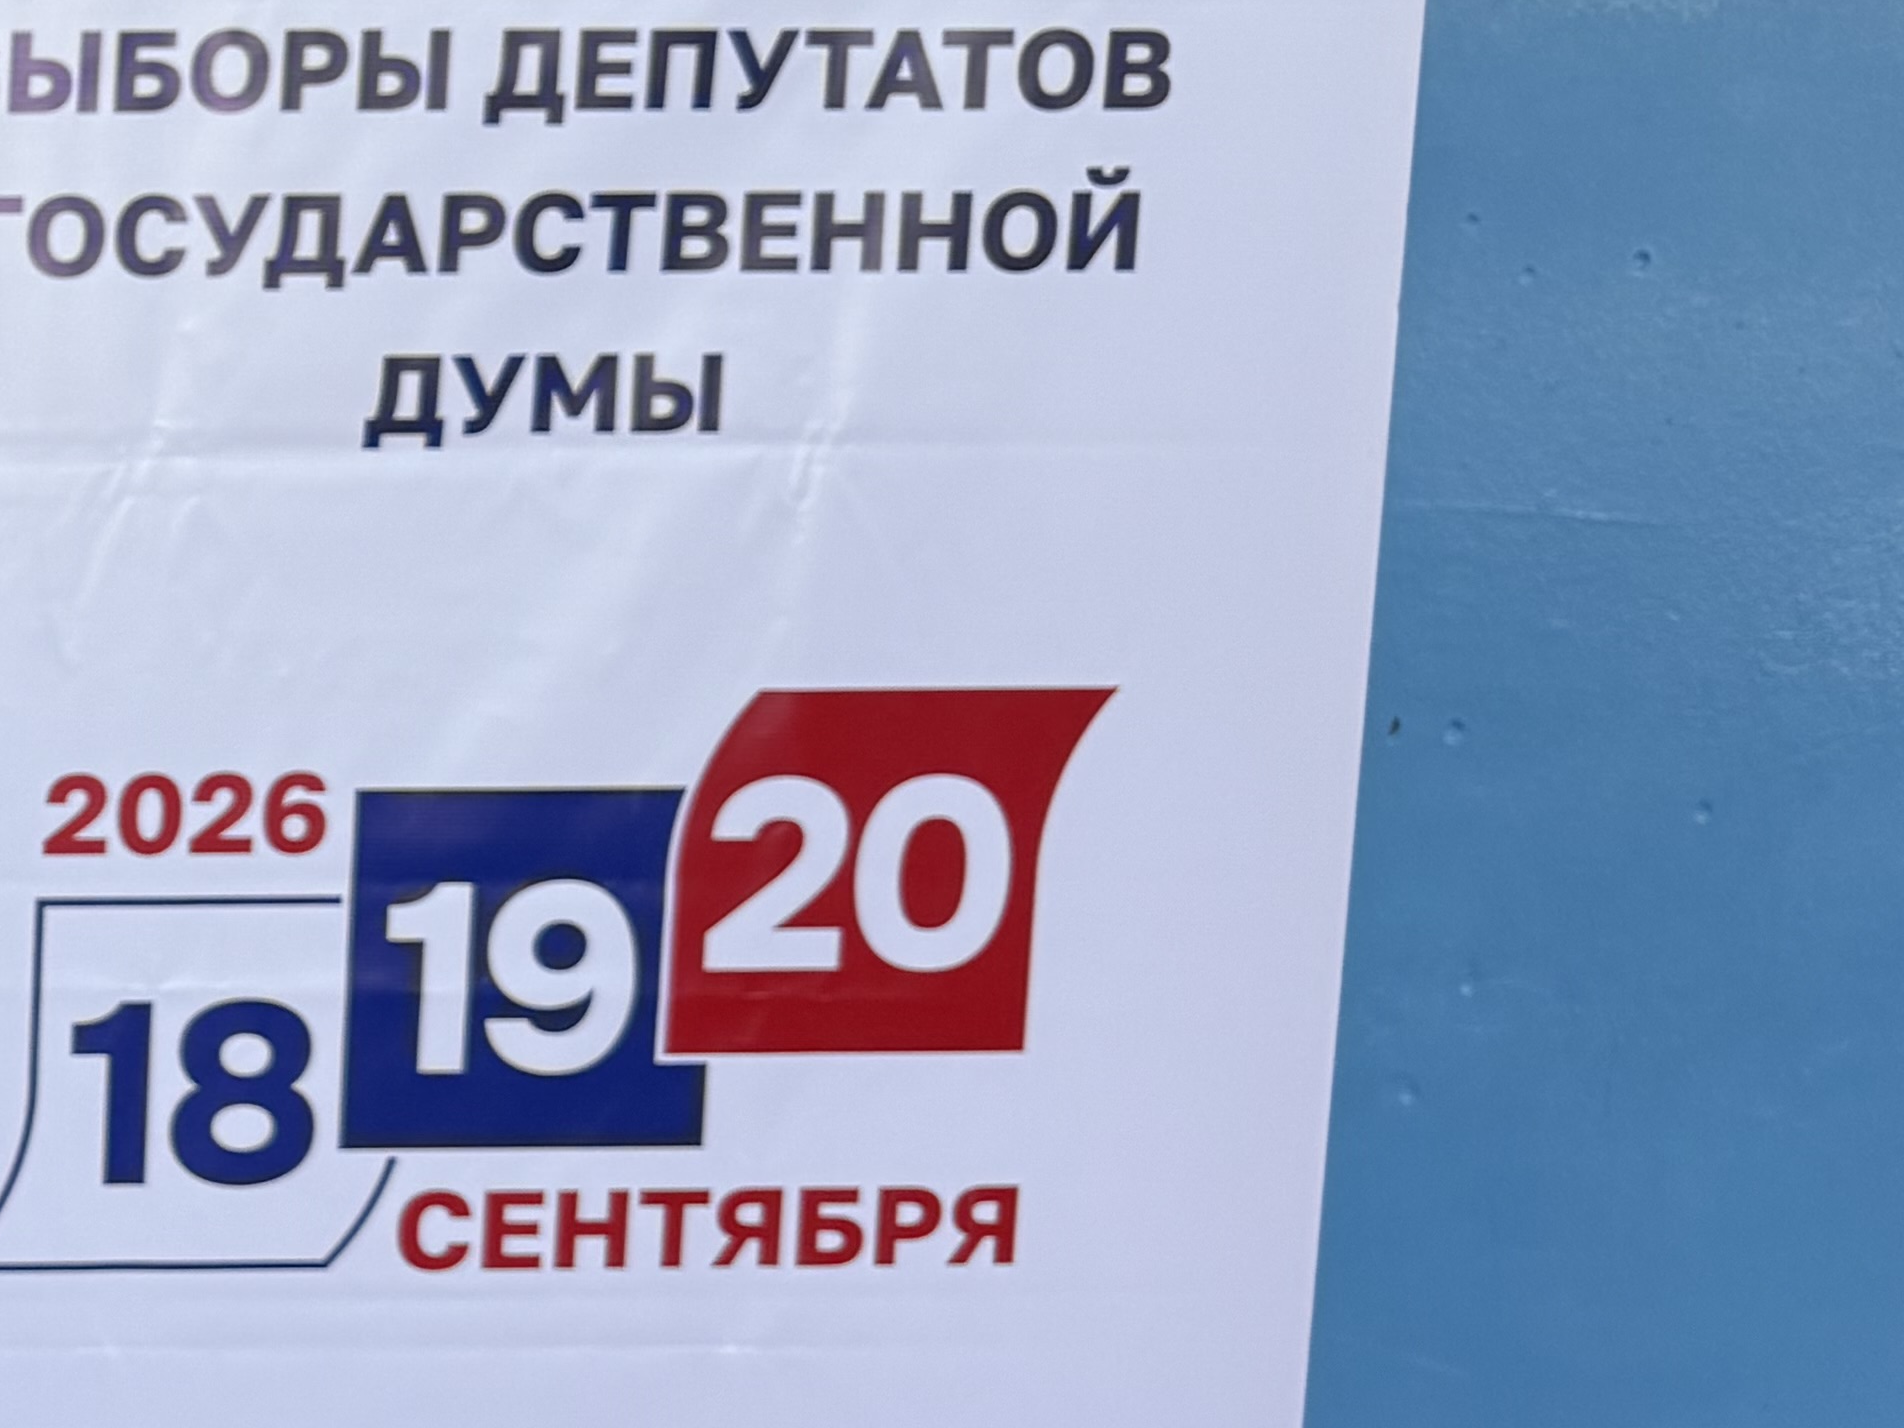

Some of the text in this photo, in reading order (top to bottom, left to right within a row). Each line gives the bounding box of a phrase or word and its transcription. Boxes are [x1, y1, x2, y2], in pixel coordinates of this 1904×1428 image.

[482, 27, 1173, 126] ДЕПУТАТОВ
[362, 353, 724, 449] ДУМЫ
[42, 772, 328, 856] 2026
[70, 773, 1013, 1187] 18 19 20
[398, 1186, 1020, 1271] СЕНТЯБРЯ
